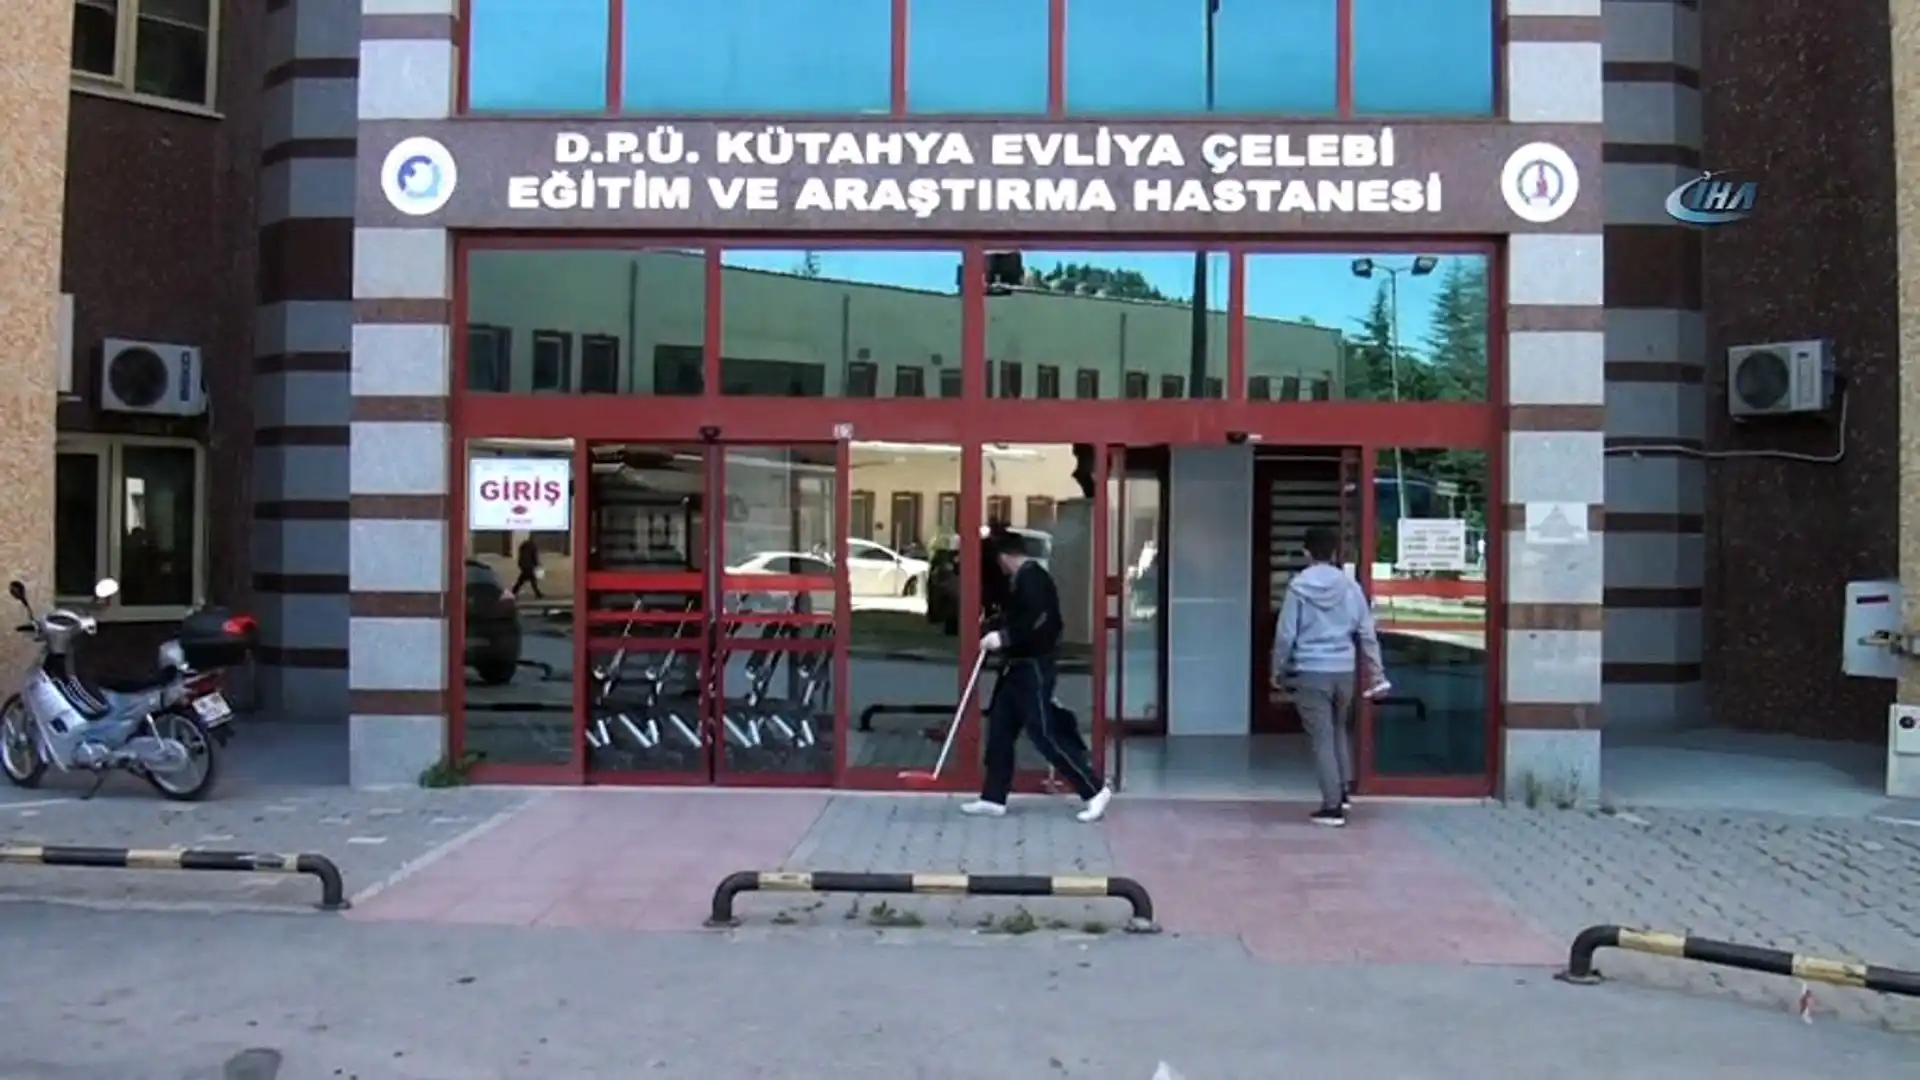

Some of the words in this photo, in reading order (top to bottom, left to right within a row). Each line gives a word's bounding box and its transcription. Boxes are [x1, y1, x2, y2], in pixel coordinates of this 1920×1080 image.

[555, 125, 700, 163] D.P.Ü.
[716, 125, 975, 167] KÜTAHYA
[991, 126, 1185, 167] EVLİYA
[1202, 127, 1395, 173] ÇELEBİ
[507, 169, 691, 209] EĞİTİM
[707, 177, 778, 210] VE
[794, 177, 1117, 218] ARAŞTIRMA
[1133, 172, 1442, 212] HASTANESİ
[480, 475, 561, 507] GİRİŞ
